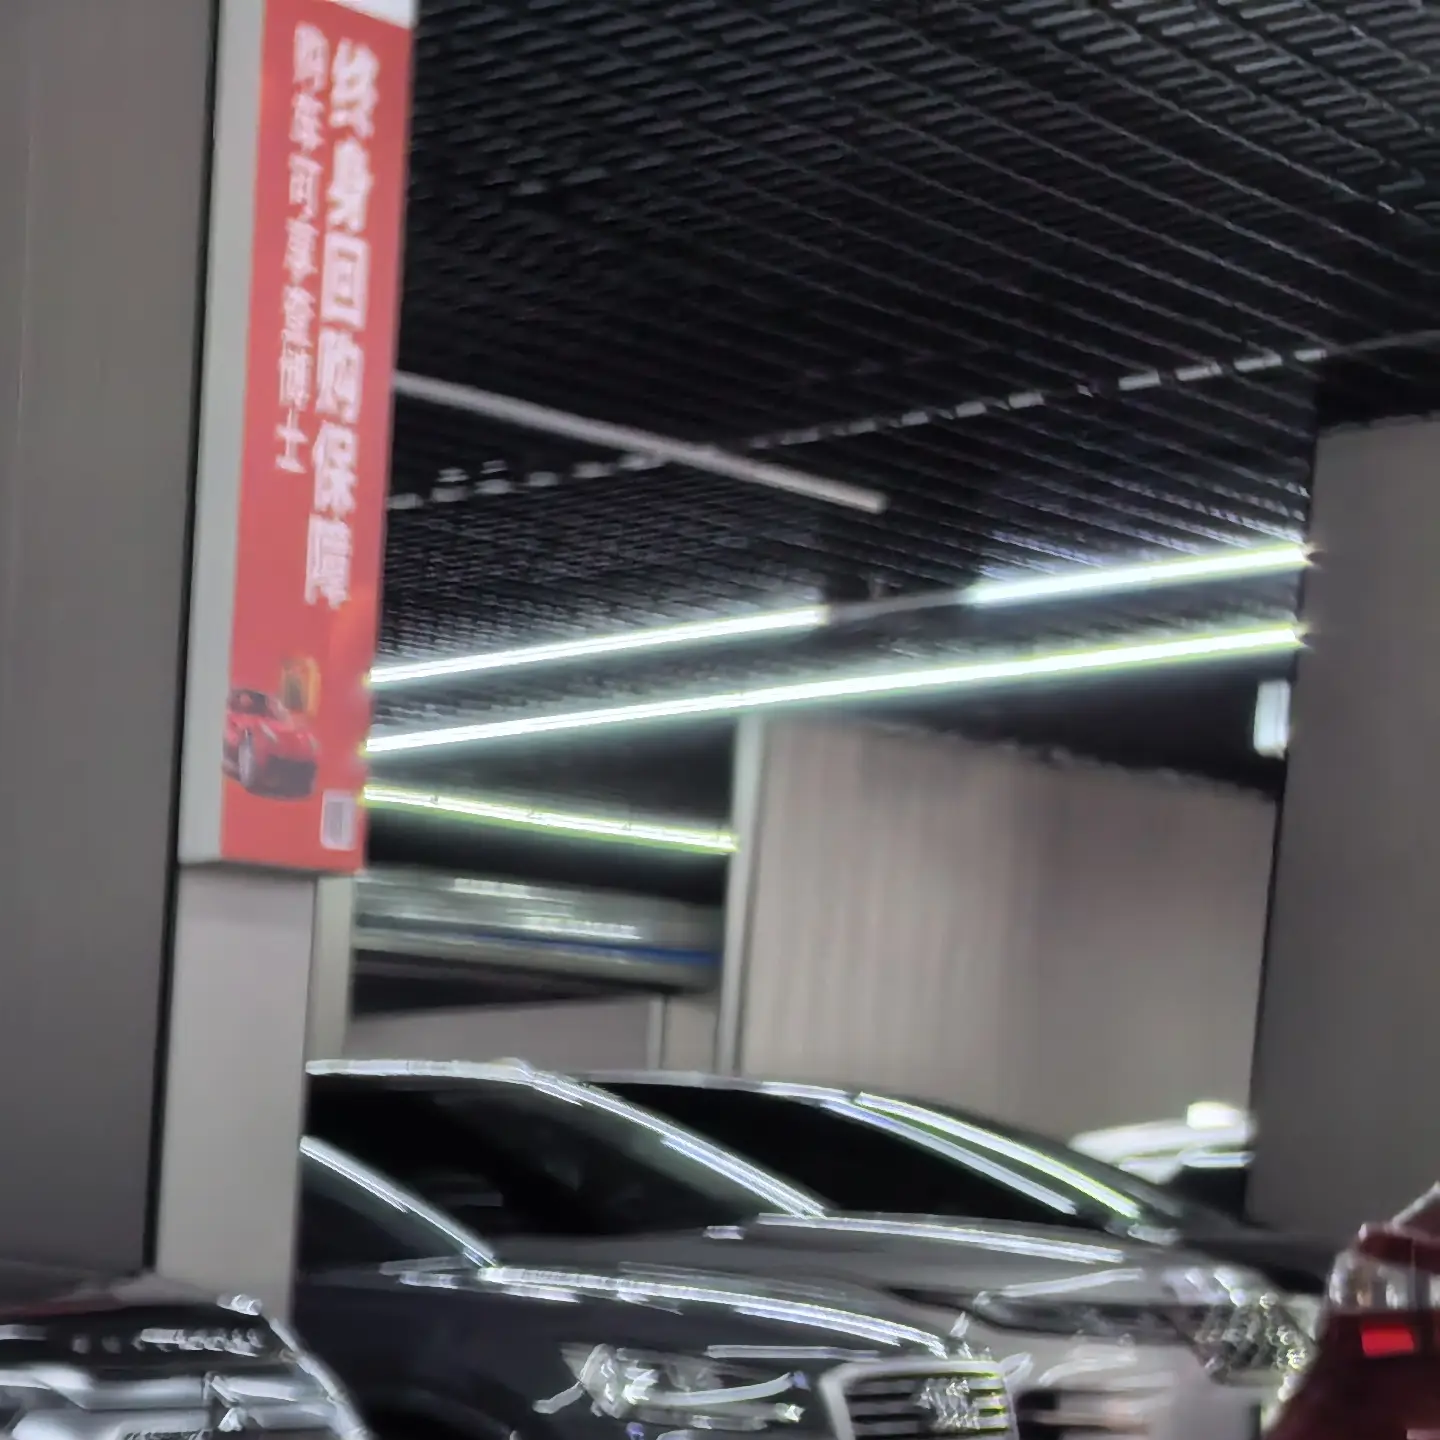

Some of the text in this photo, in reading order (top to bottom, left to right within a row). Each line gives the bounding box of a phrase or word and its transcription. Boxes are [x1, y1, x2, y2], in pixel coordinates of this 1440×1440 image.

[302, 35, 379, 609] 终身回购保障
